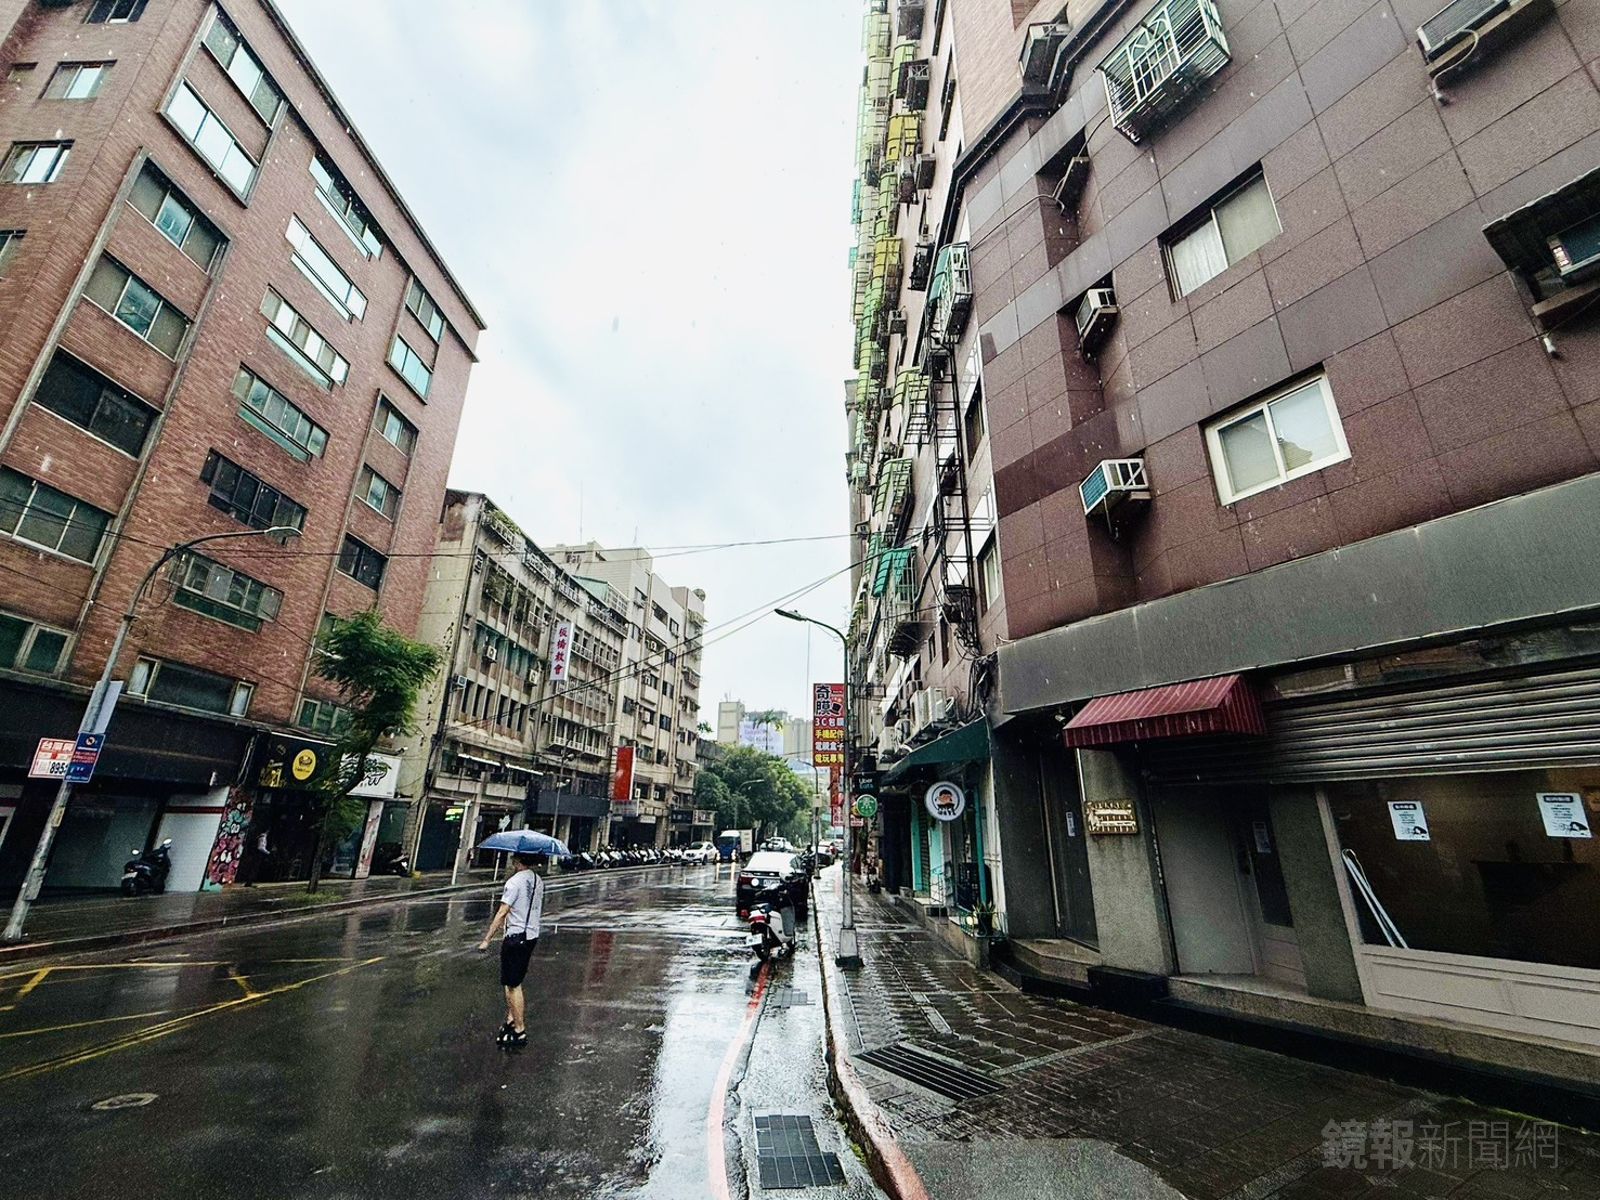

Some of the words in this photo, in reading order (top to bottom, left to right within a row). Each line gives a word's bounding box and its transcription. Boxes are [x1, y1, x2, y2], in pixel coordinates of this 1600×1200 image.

[815, 685, 831, 716] 奇膜
[815, 729, 845, 739] 手機配件
